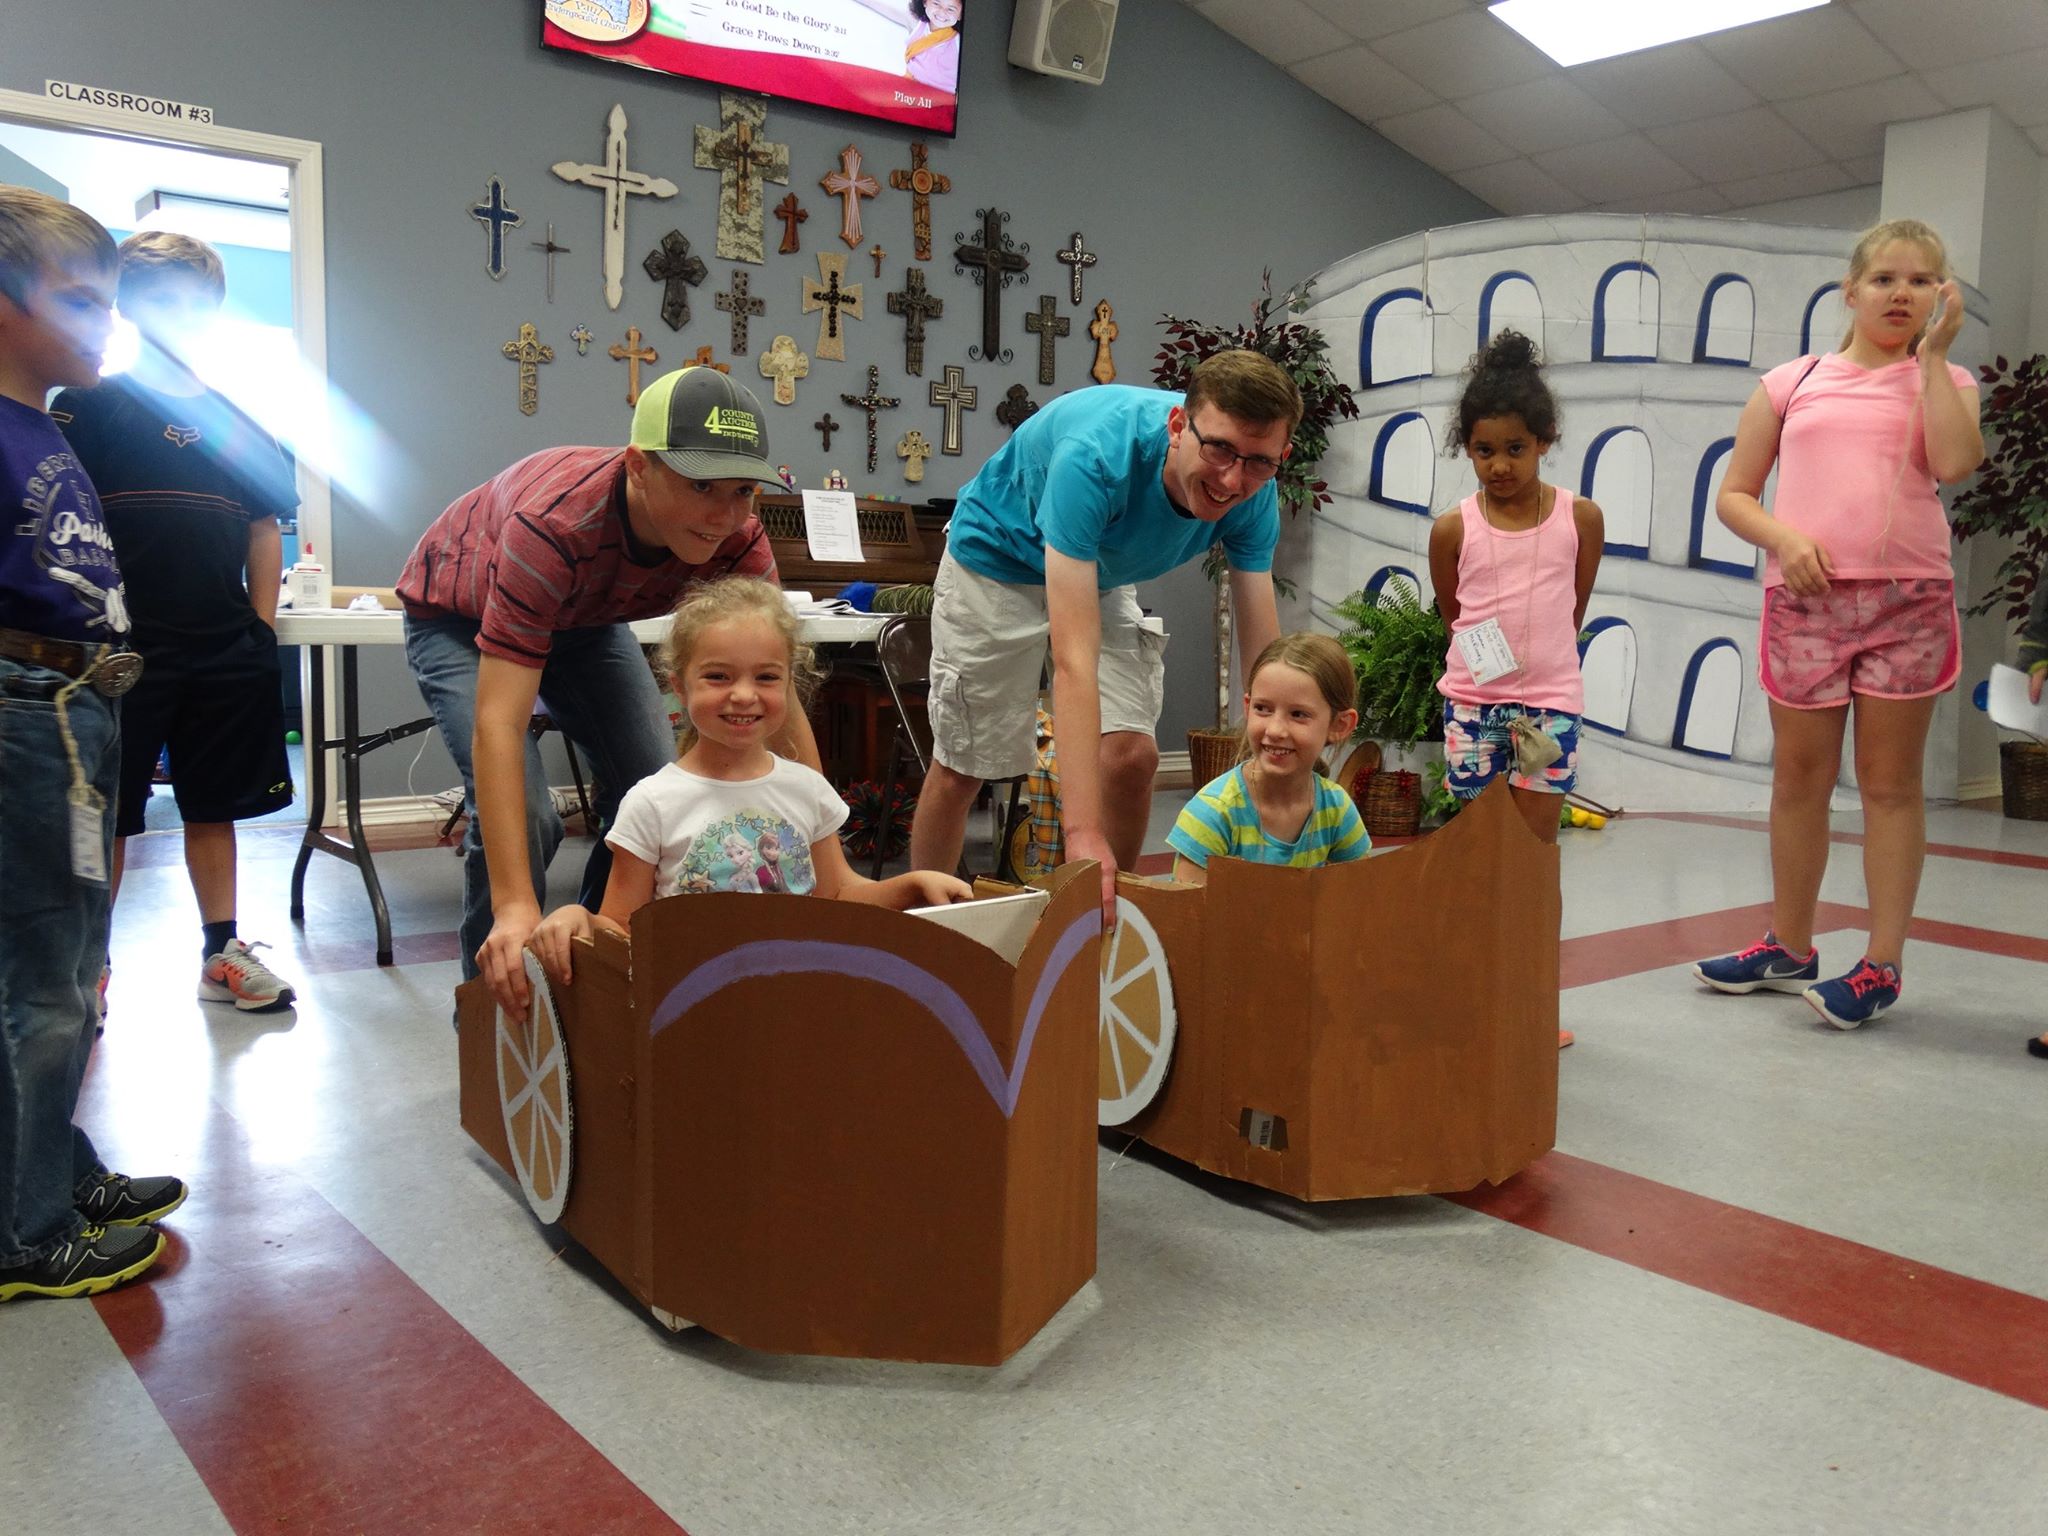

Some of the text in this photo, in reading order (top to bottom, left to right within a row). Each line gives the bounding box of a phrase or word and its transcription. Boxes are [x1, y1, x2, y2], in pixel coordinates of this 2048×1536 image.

[546, 2, 599, 25] nderground
[741, 0, 762, 14] God
[765, 5, 779, 18] Be
[782, 11, 800, 23] the
[803, 16, 831, 32] Glory
[722, 21, 754, 38] Grace
[757, 29, 789, 47] Flows
[792, 38, 822, 54] Down
[49, 82, 212, 124] CLASSROOM #3
[894, 90, 932, 109] Play All
[704, 405, 722, 434] 4
[720, 417, 758, 429] AUCTION
[721, 408, 755, 421] COUNTY
